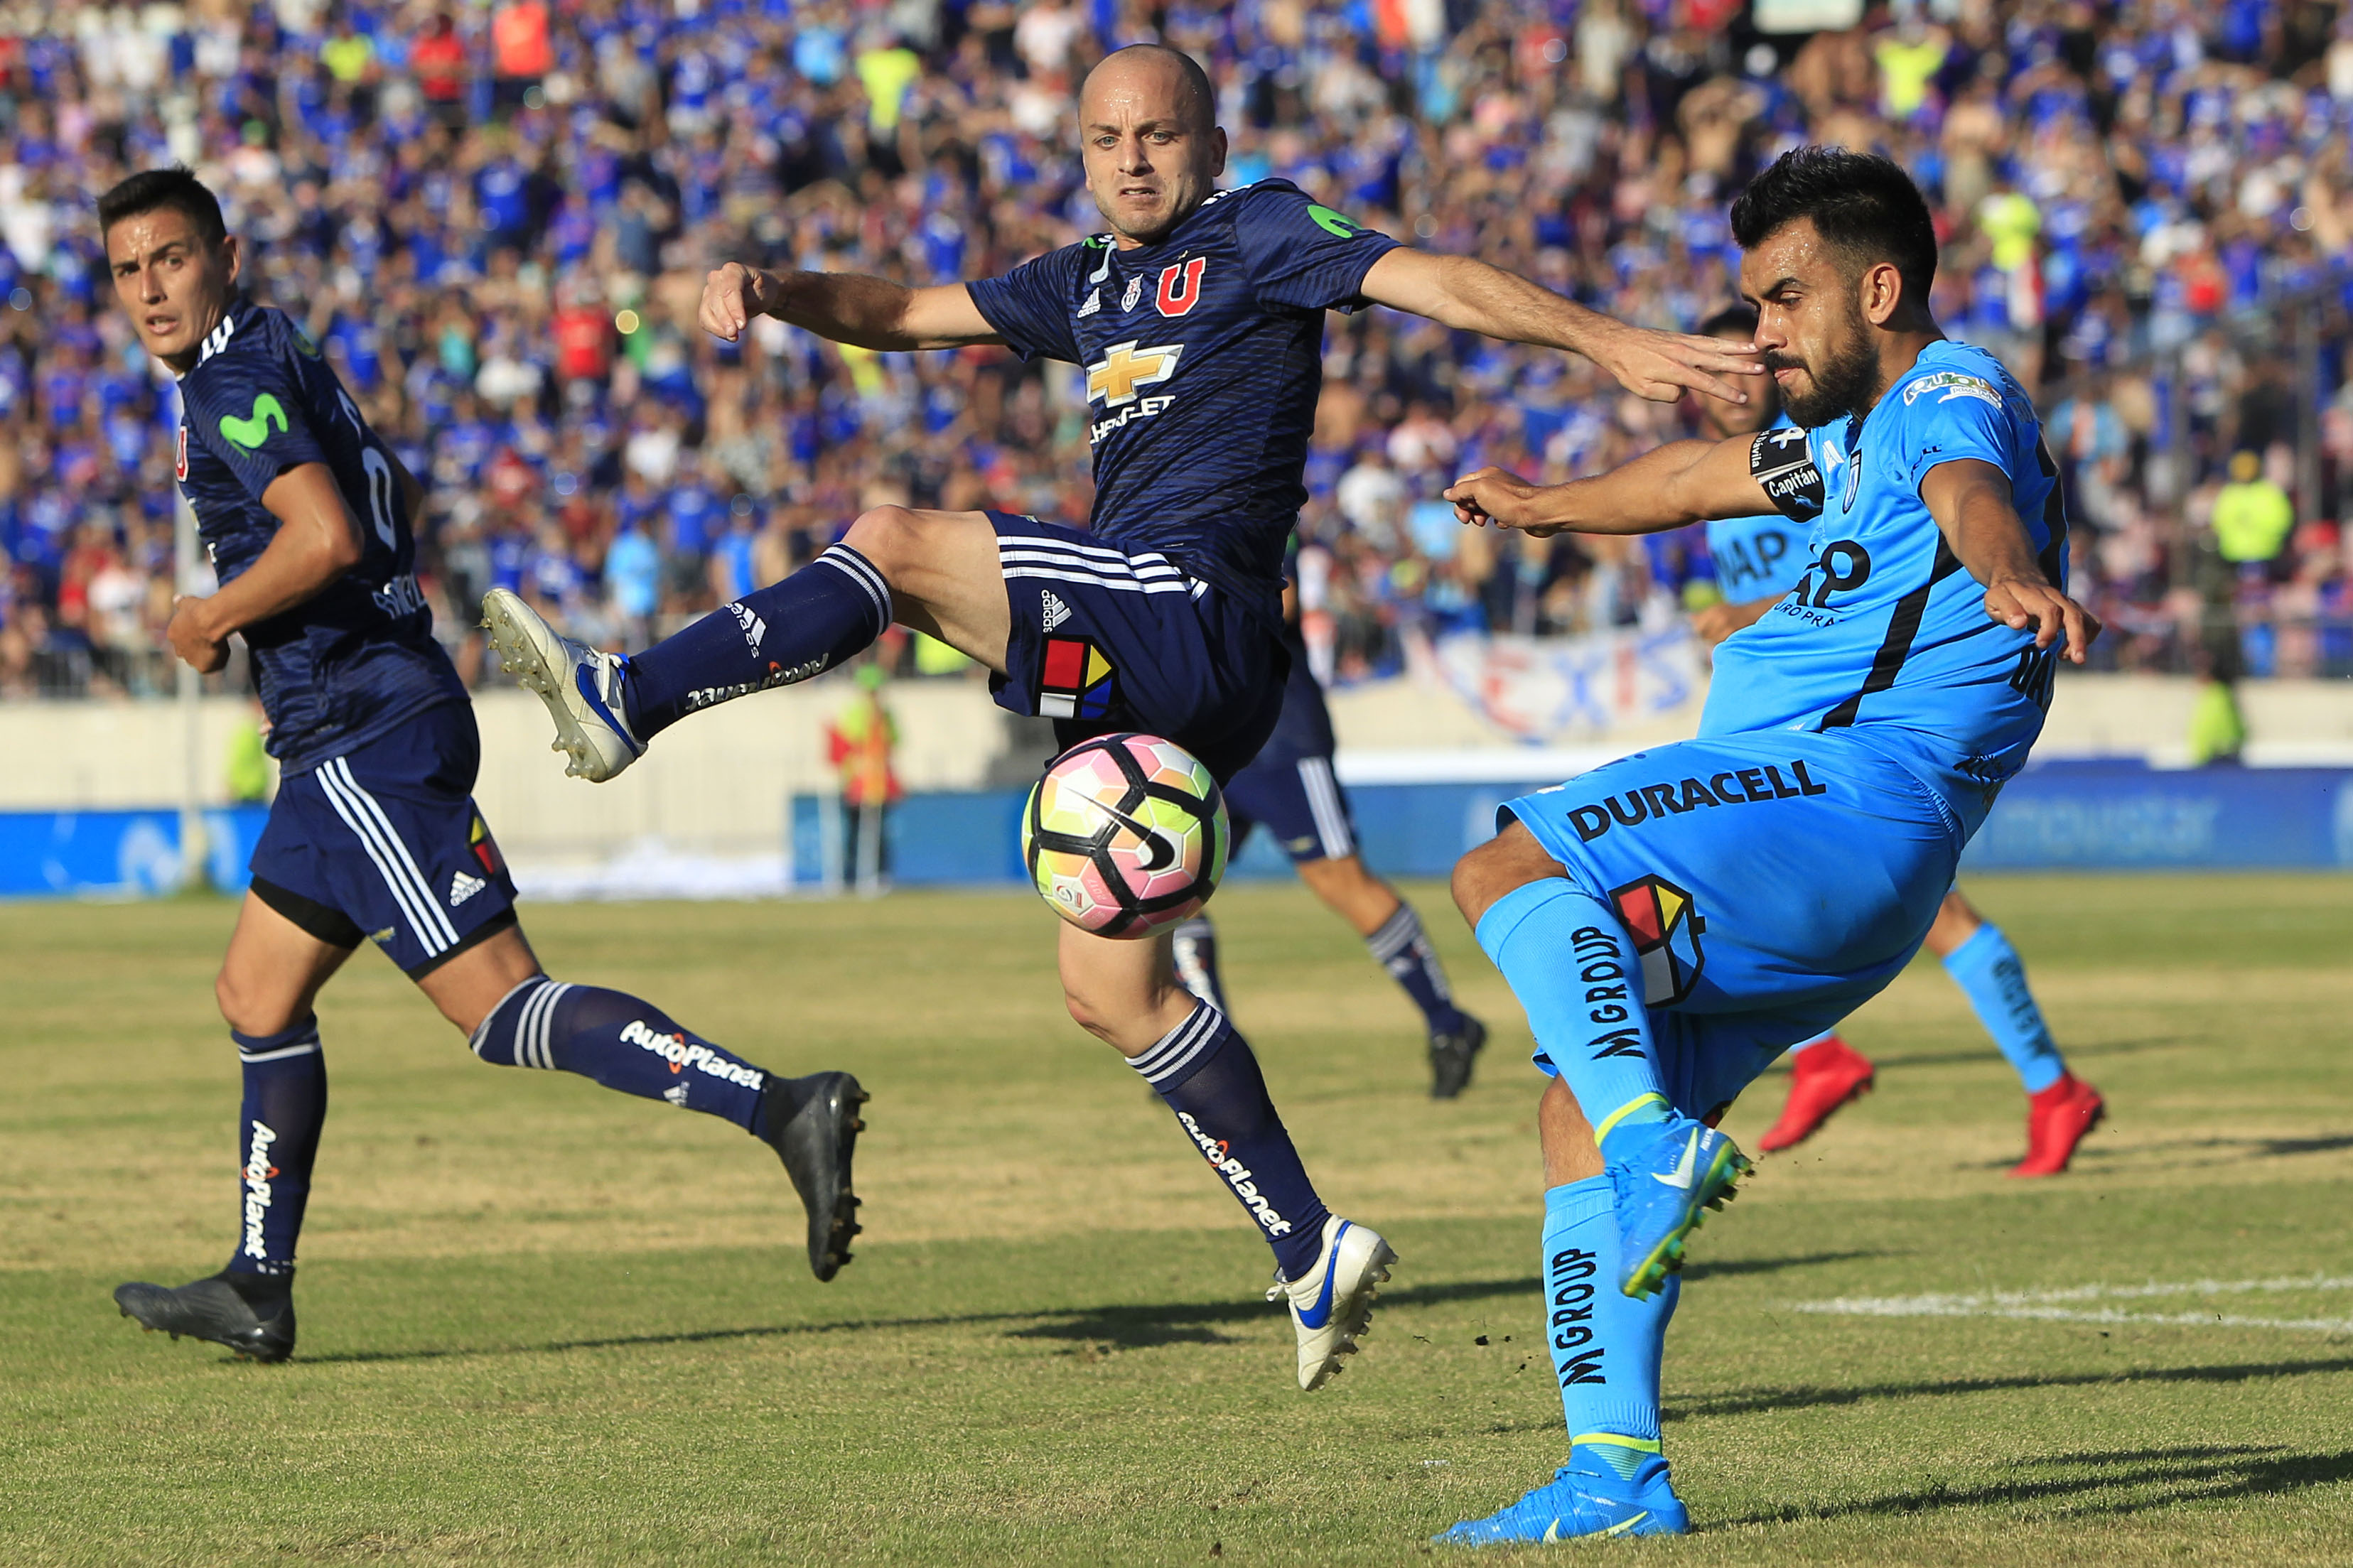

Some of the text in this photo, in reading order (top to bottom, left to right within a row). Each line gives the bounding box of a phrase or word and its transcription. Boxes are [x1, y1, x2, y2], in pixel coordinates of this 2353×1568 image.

[1155, 256, 1206, 318] U
[1768, 467, 1821, 497] Capitán
[724, 602, 760, 659] adidas
[1041, 589, 1053, 633] adidas
[1566, 759, 1826, 843] DURACELL
[619, 1020, 764, 1091] AutoPlanet
[244, 1119, 278, 1260] AutoPlanet
[1178, 1111, 1292, 1236] AutoPlanet
